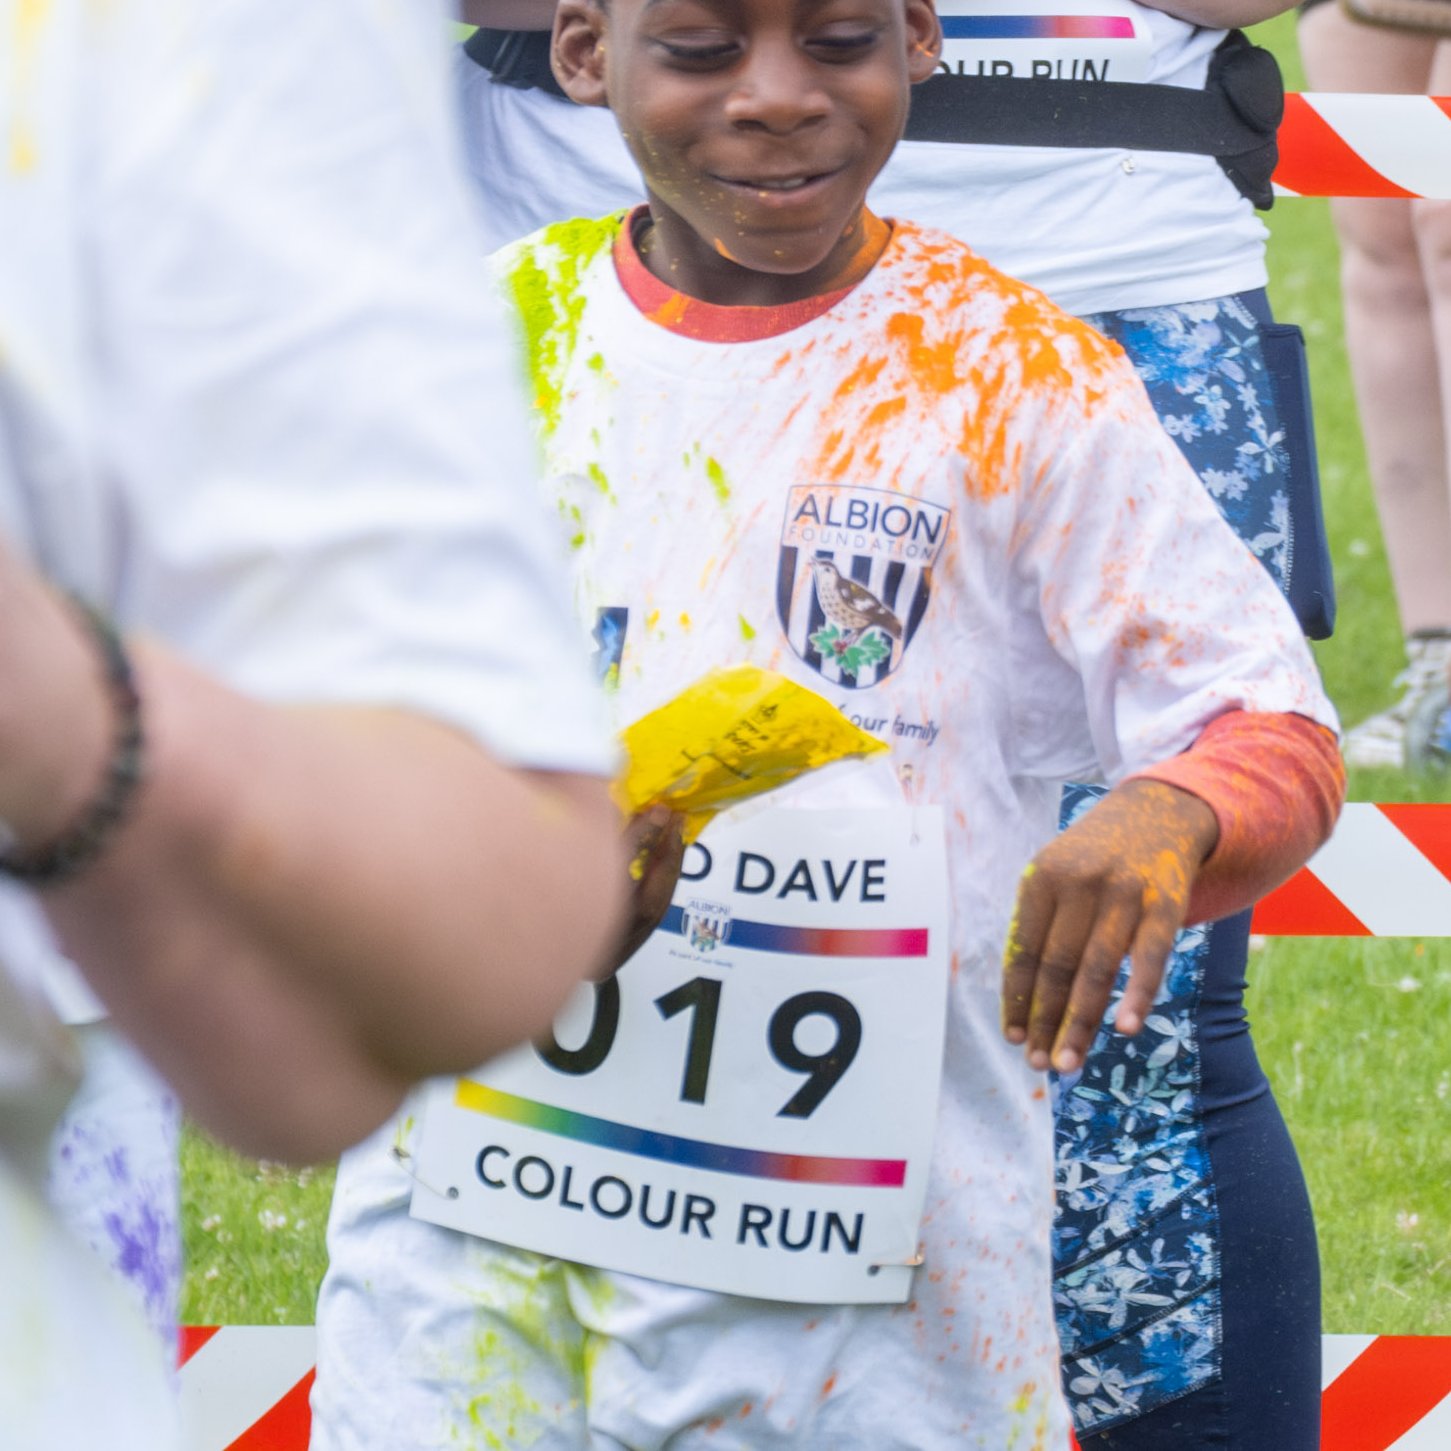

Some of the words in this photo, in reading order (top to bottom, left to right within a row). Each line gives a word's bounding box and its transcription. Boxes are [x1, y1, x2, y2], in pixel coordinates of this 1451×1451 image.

[793, 493, 943, 545] ALBION
[734, 850, 887, 904] DAVE
[474, 1144, 718, 1239] COLOUR
[737, 1203, 865, 1256] RUN
